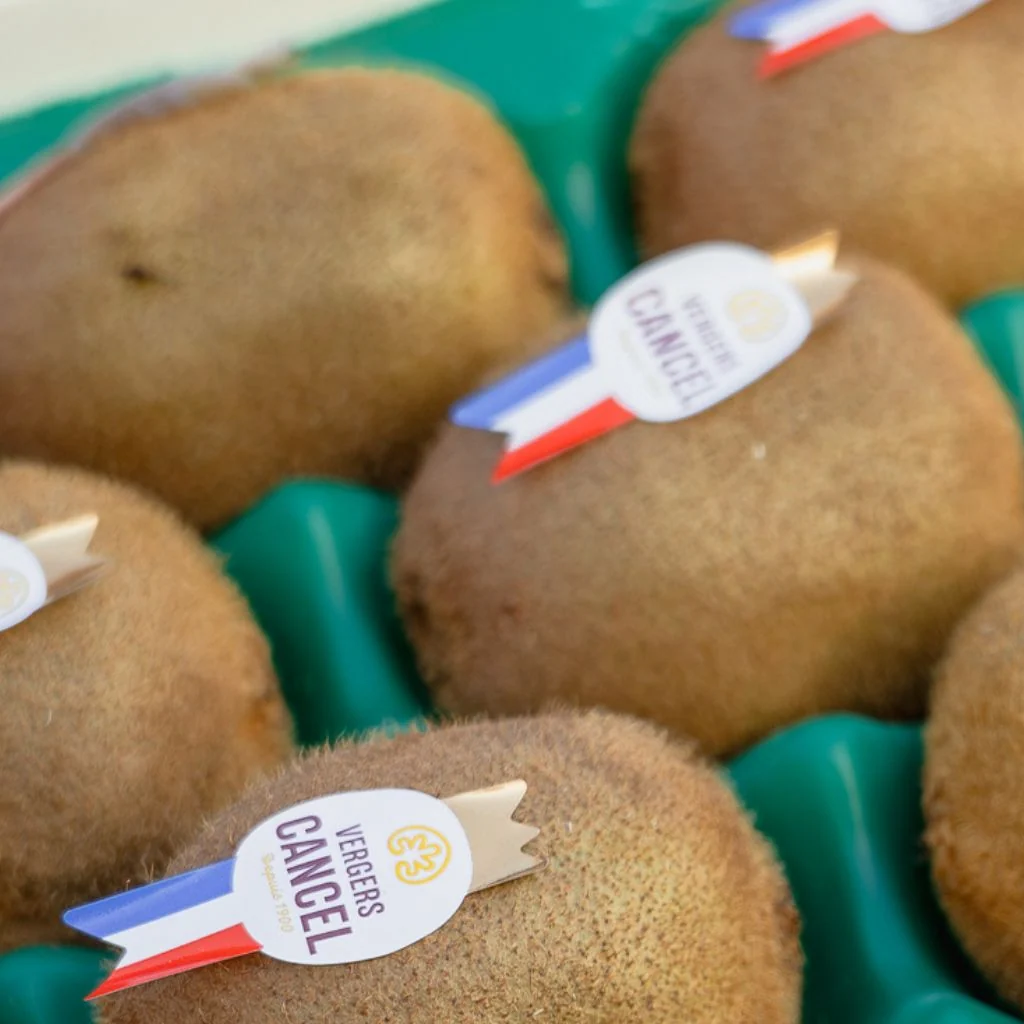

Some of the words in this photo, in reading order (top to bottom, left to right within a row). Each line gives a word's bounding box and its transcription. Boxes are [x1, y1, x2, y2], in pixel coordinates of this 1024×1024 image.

[626, 286, 715, 411] CANCEL
[275, 814, 353, 955] CANCEL
[335, 822, 385, 918] VERGERS
